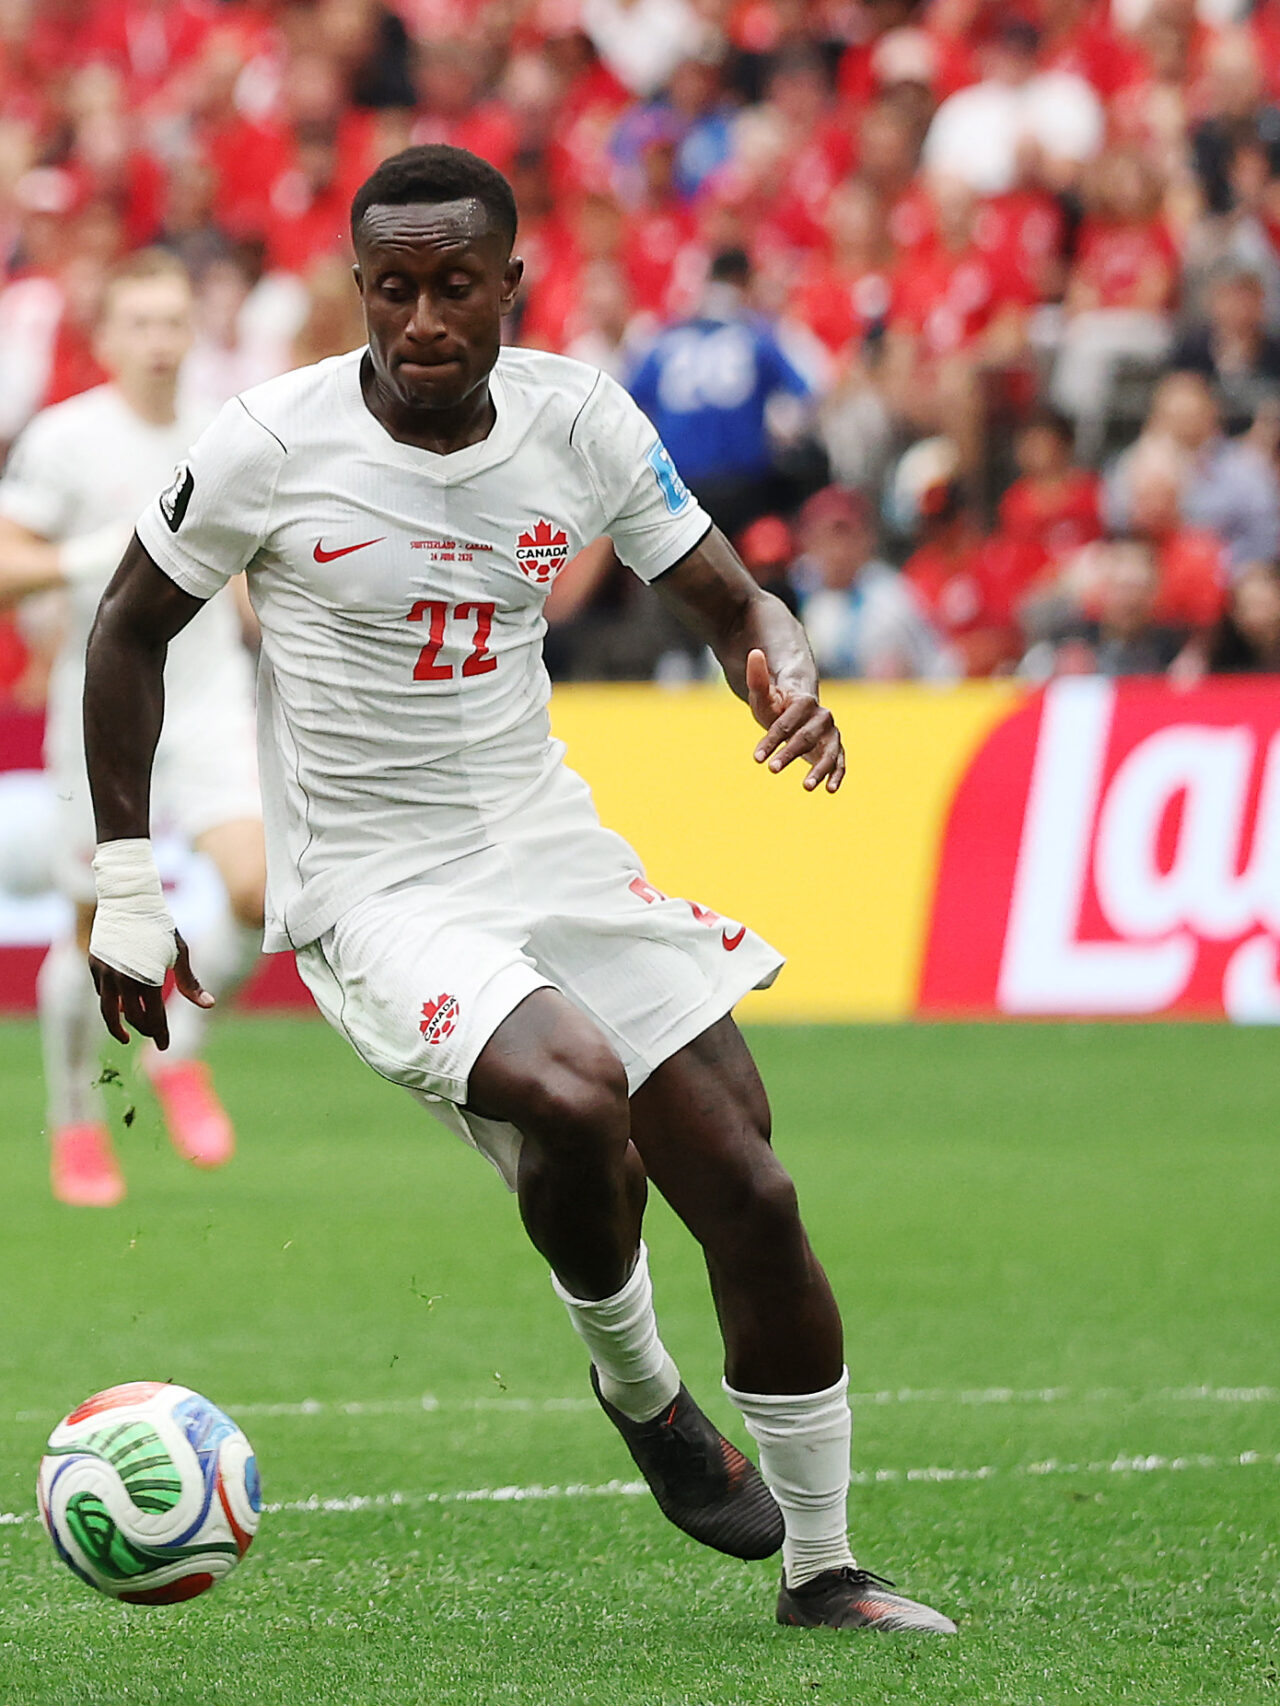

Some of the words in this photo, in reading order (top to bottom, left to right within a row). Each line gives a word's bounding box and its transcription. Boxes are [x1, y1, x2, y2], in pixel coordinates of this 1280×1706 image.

[516, 547, 568, 559] CANADA
[406, 600, 497, 681] 22
[424, 998, 457, 1041] CANADA
